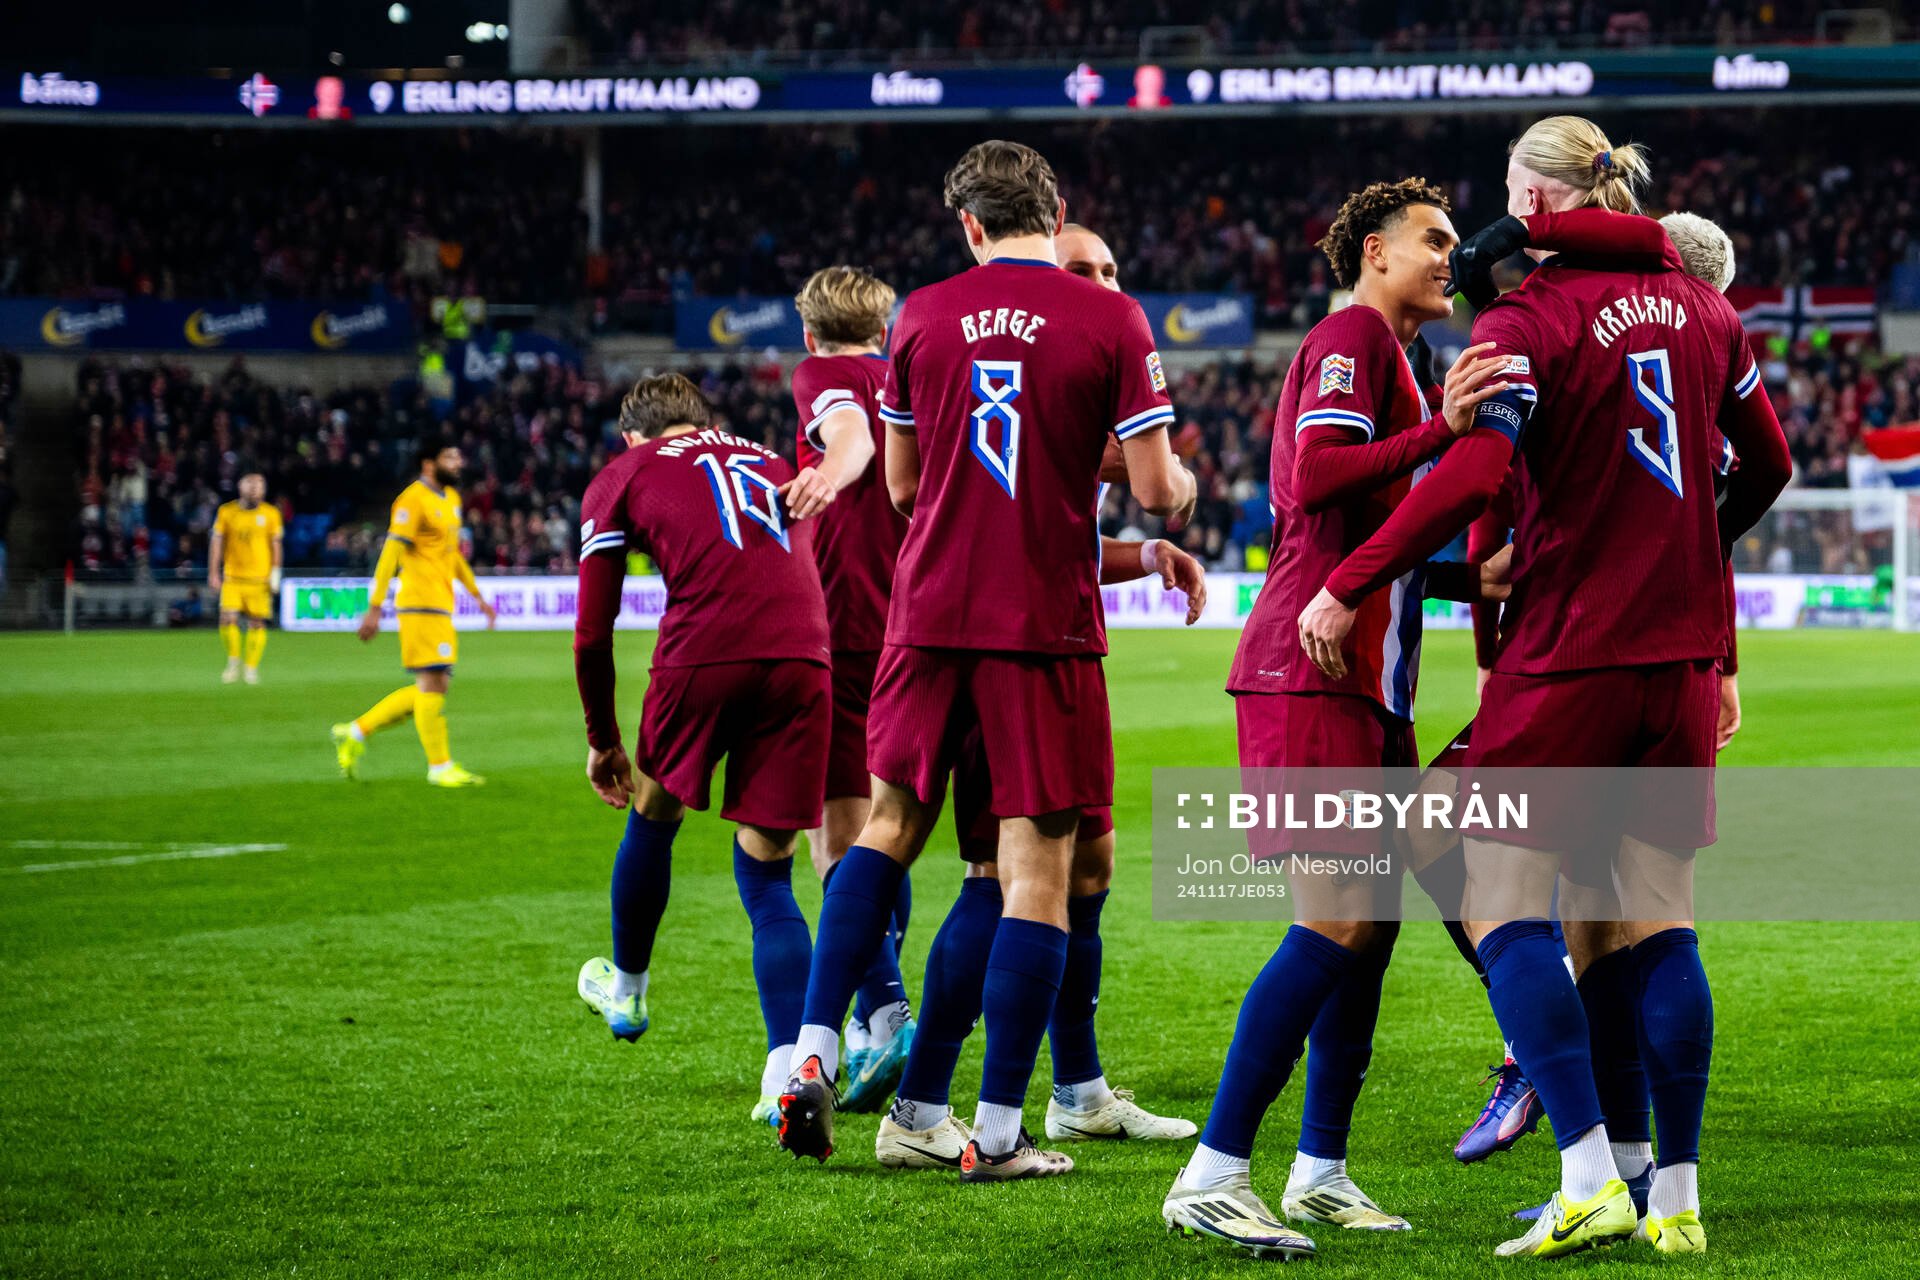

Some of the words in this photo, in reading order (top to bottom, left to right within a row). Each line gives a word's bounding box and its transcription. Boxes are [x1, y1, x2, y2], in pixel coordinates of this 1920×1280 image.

[369, 80, 394, 113] 9
[402, 80, 511, 113] ERLING
[514, 78, 612, 112] BRAUT
[614, 76, 760, 111] HAALAND
[1187, 68, 1213, 102] 9
[1219, 68, 1331, 101] ERLING
[1333, 66, 1438, 100] BRAUT
[1439, 61, 1593, 98] HAALAND
[960, 308, 1046, 344] BERGE
[1592, 295, 1687, 348] HAALAND
[970, 360, 1022, 500] 8
[1480, 404, 1521, 427] RESPECT
[1626, 348, 1683, 499] 9
[693, 453, 792, 553] 16
